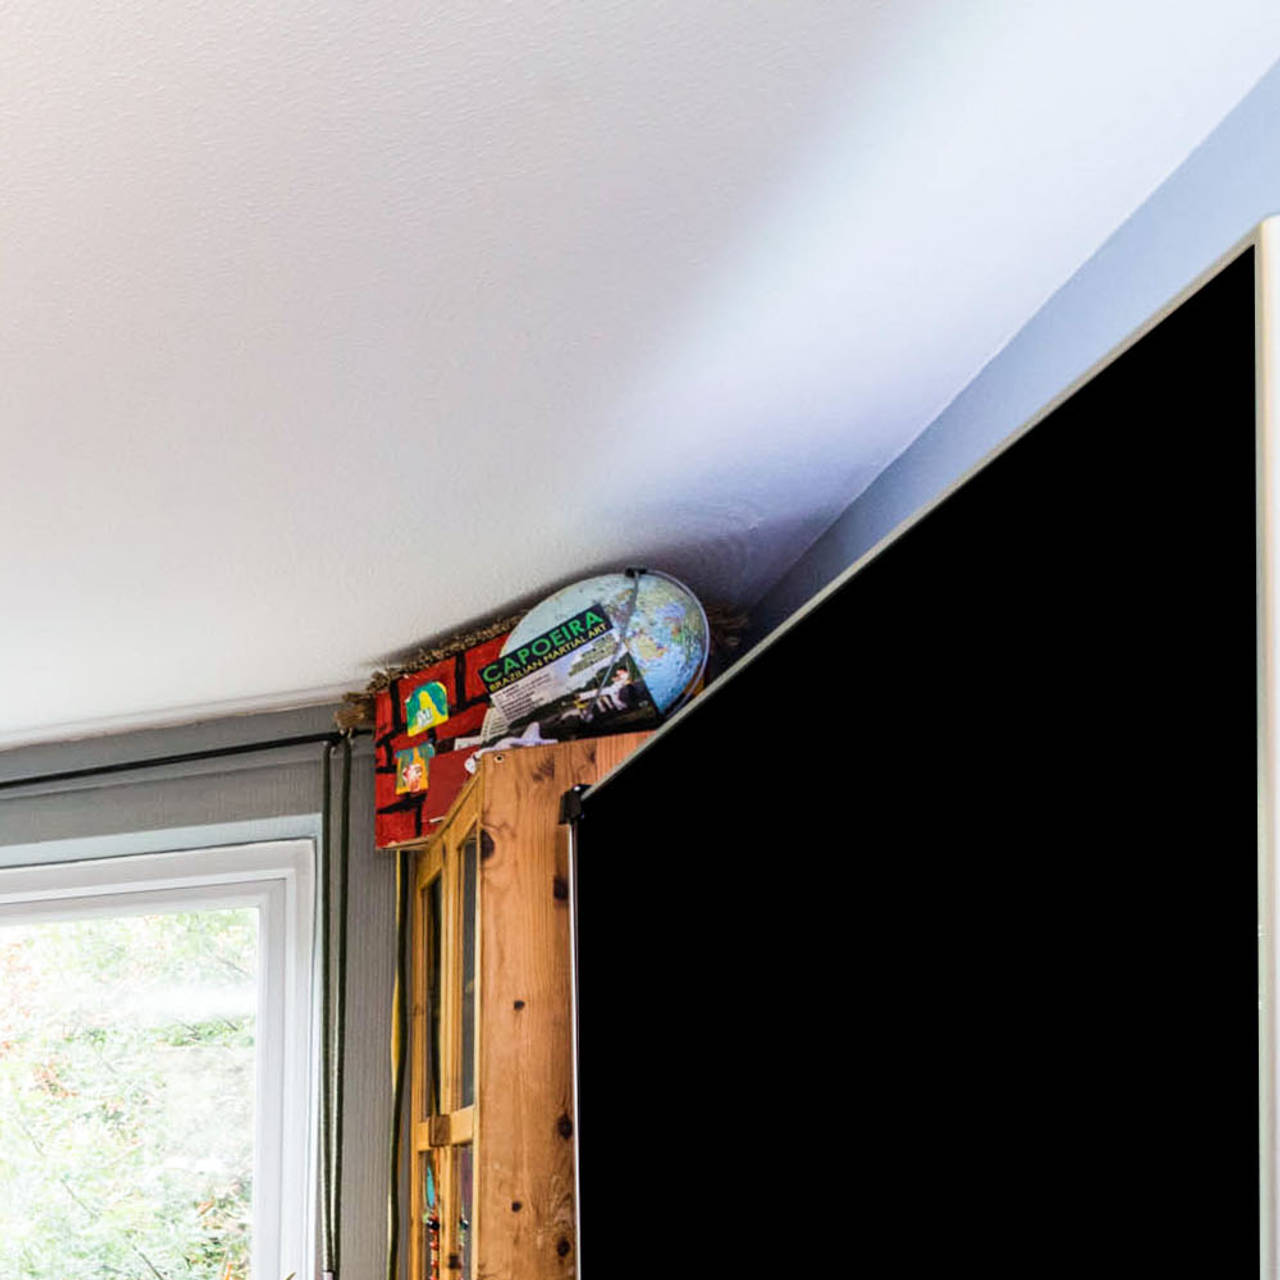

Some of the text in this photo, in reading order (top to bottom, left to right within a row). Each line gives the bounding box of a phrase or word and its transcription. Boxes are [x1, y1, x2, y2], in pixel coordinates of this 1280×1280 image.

[482, 610, 604, 683] CAPOEIRA
[489, 660, 543, 692] BRAZILIAN
[543, 637, 587, 665] MARTIAL
[588, 623, 608, 639] ART
